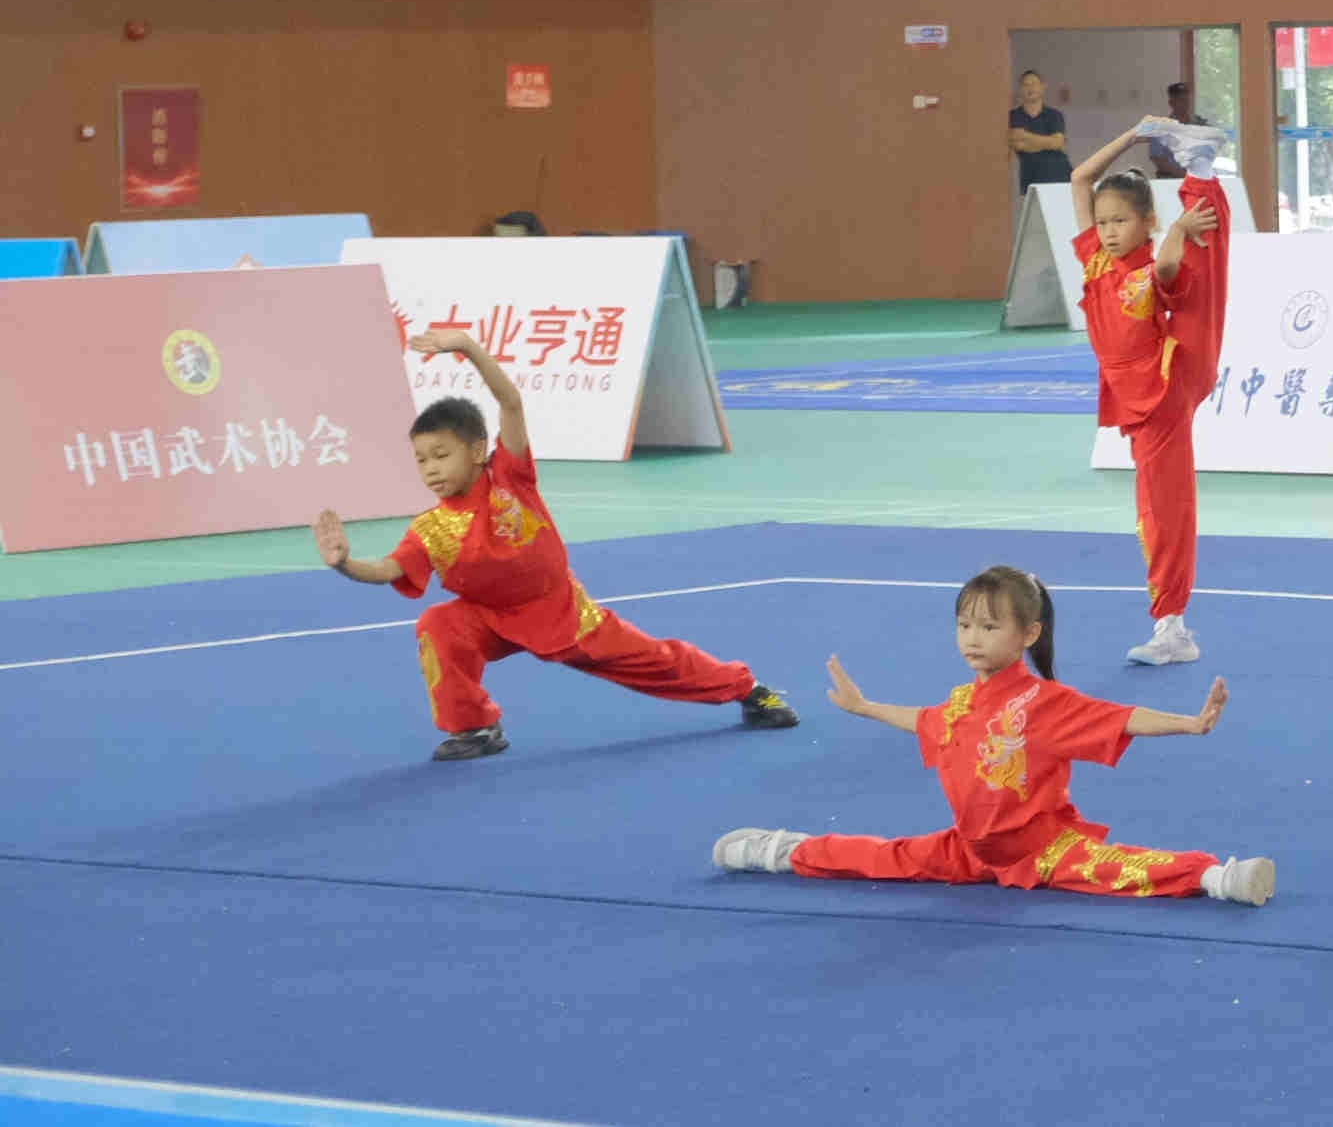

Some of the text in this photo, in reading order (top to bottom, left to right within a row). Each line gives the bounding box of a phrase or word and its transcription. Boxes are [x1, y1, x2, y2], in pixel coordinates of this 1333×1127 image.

[414, 371, 613, 392] DAYENGTONG
[63, 413, 351, 487] 中国武术协会
